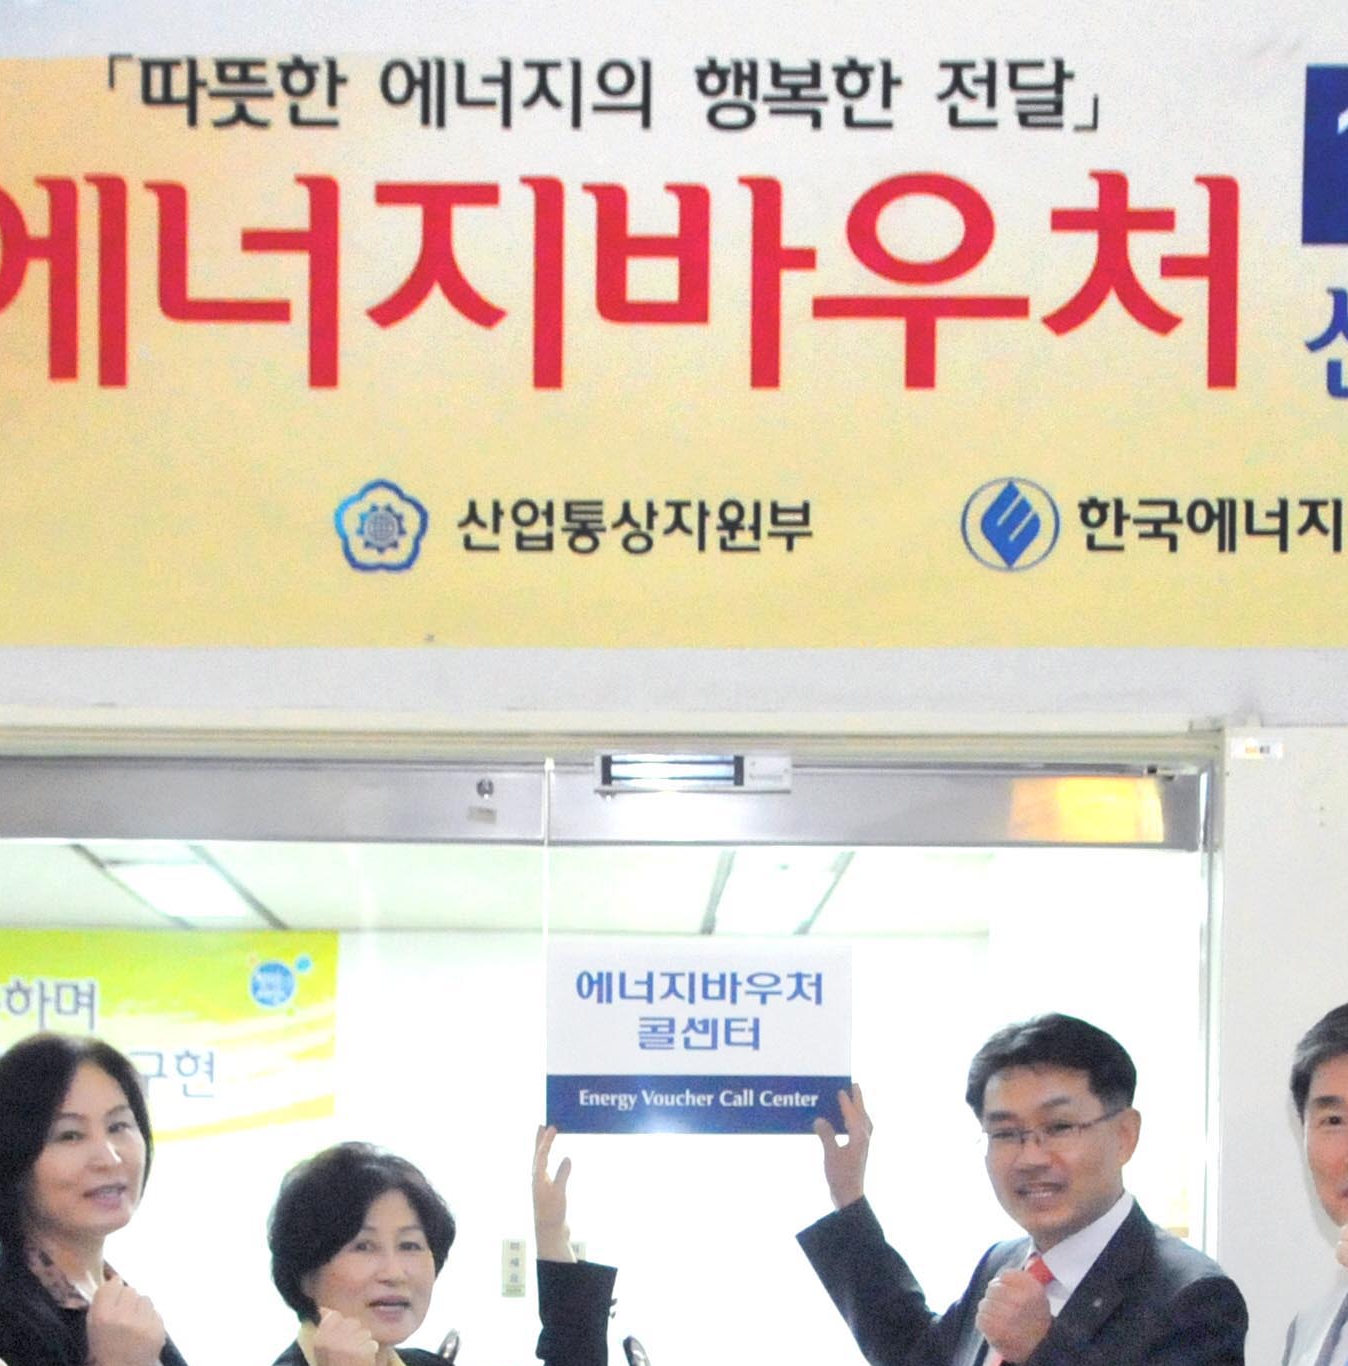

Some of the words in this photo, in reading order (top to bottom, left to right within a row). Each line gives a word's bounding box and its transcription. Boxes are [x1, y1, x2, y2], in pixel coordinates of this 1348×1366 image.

[380, 58, 654, 130] 에너지의
[694, 58, 904, 130] 행복한
[457, 499, 815, 555] 산업통상자원부
[575, 970, 824, 1006] 에너지바우처
[638, 1016, 762, 1052] 콜센터
[579, 1088, 638, 1111] Energy
[641, 1088, 715, 1107] Voucher
[719, 1088, 754, 1107] Call
[759, 1089, 819, 1107] Center
